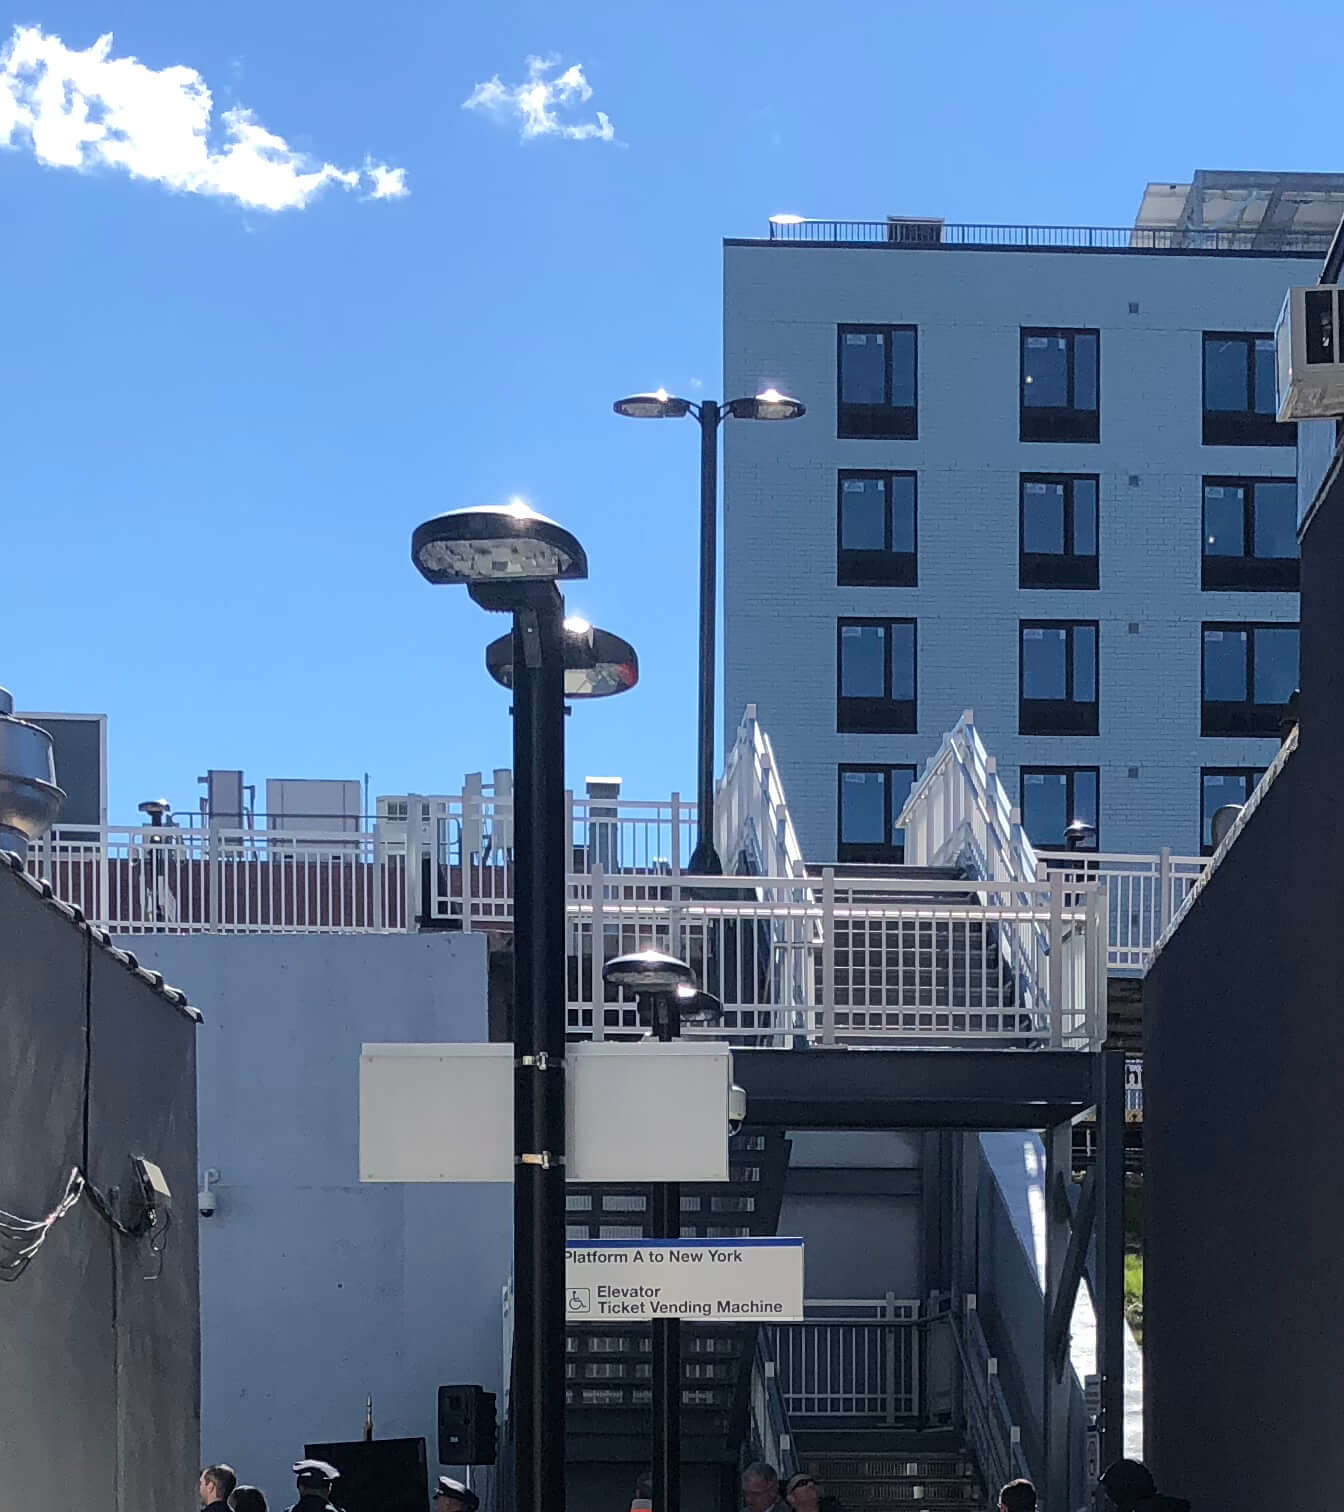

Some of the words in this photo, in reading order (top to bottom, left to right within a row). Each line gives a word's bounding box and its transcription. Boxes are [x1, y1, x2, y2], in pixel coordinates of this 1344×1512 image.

[633, 1250, 644, 1263] A
[649, 1251, 664, 1263] to
[669, 1249, 703, 1262] New
[708, 1249, 742, 1262] York
[597, 1285, 661, 1298] Elevator
[598, 1301, 646, 1314] Ticket
[650, 1301, 712, 1316] Vending
[716, 1300, 783, 1313] Machine
